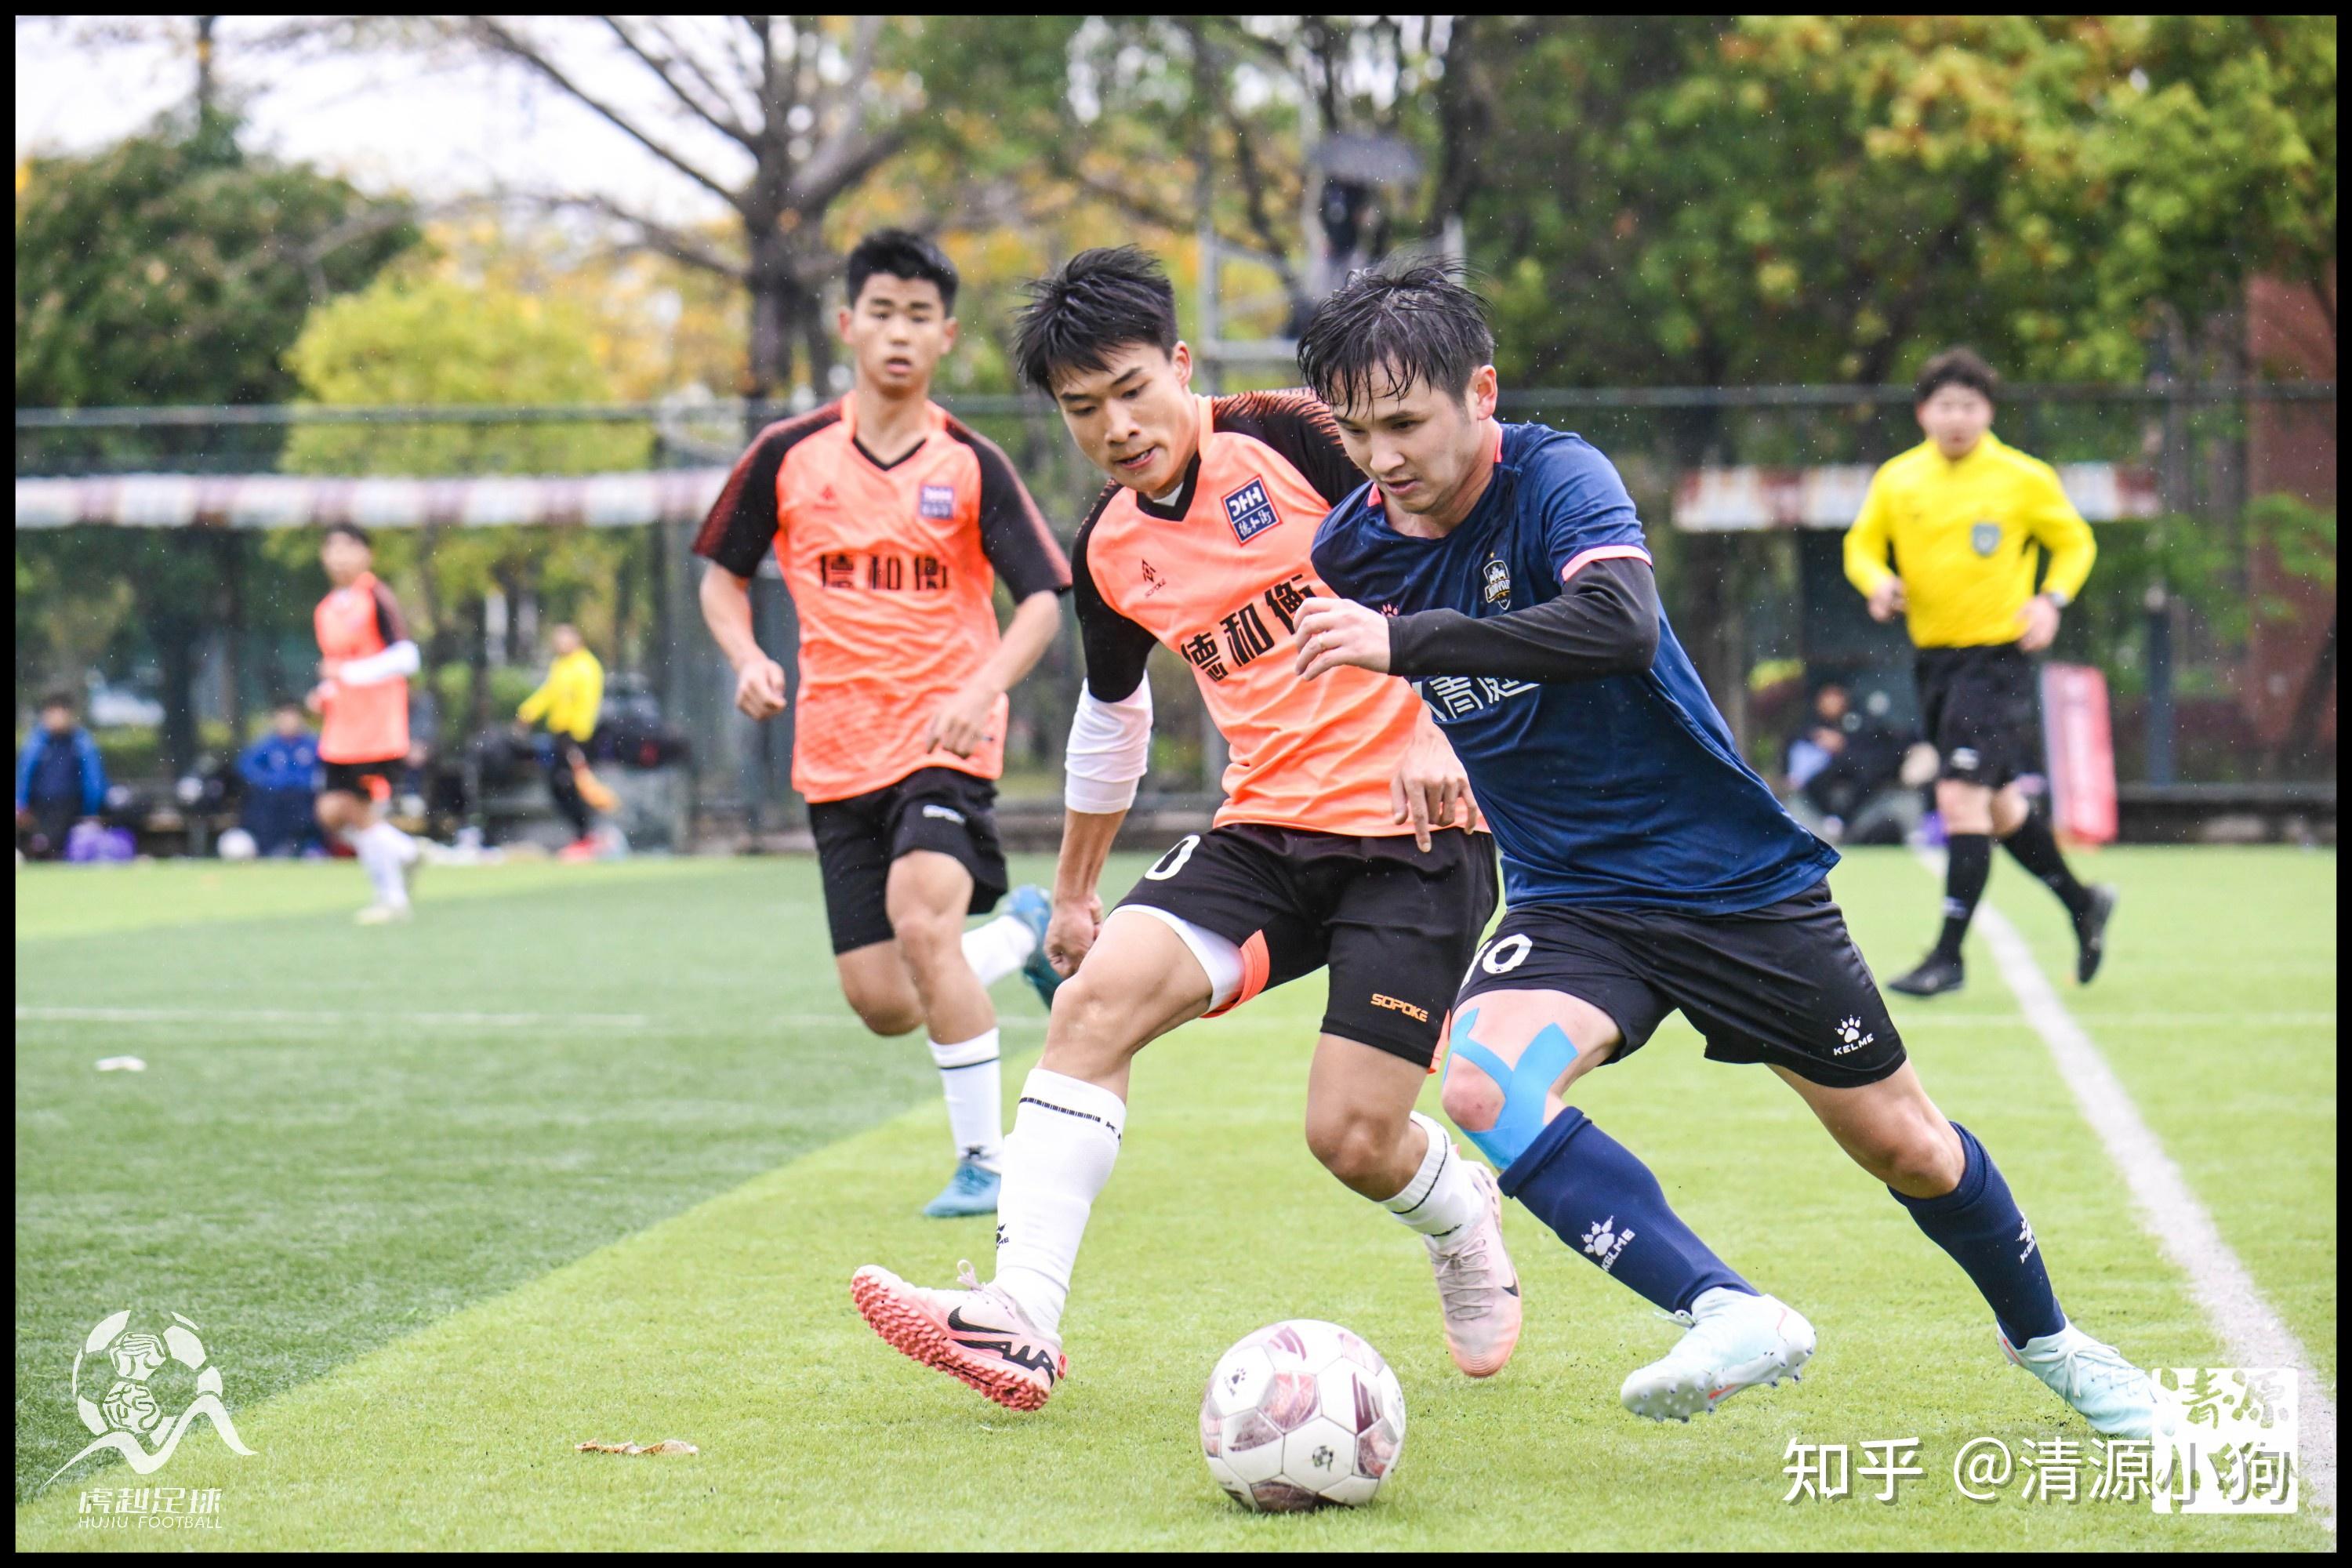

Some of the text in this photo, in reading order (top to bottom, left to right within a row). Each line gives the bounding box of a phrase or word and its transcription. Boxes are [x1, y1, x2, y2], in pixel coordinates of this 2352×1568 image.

[1180, 573, 1319, 683] 德和衡
[1370, 993, 1429, 1022] SOPOKE
[1832, 1032, 1875, 1057] KELME
[1600, 1227, 1636, 1272] KELME
